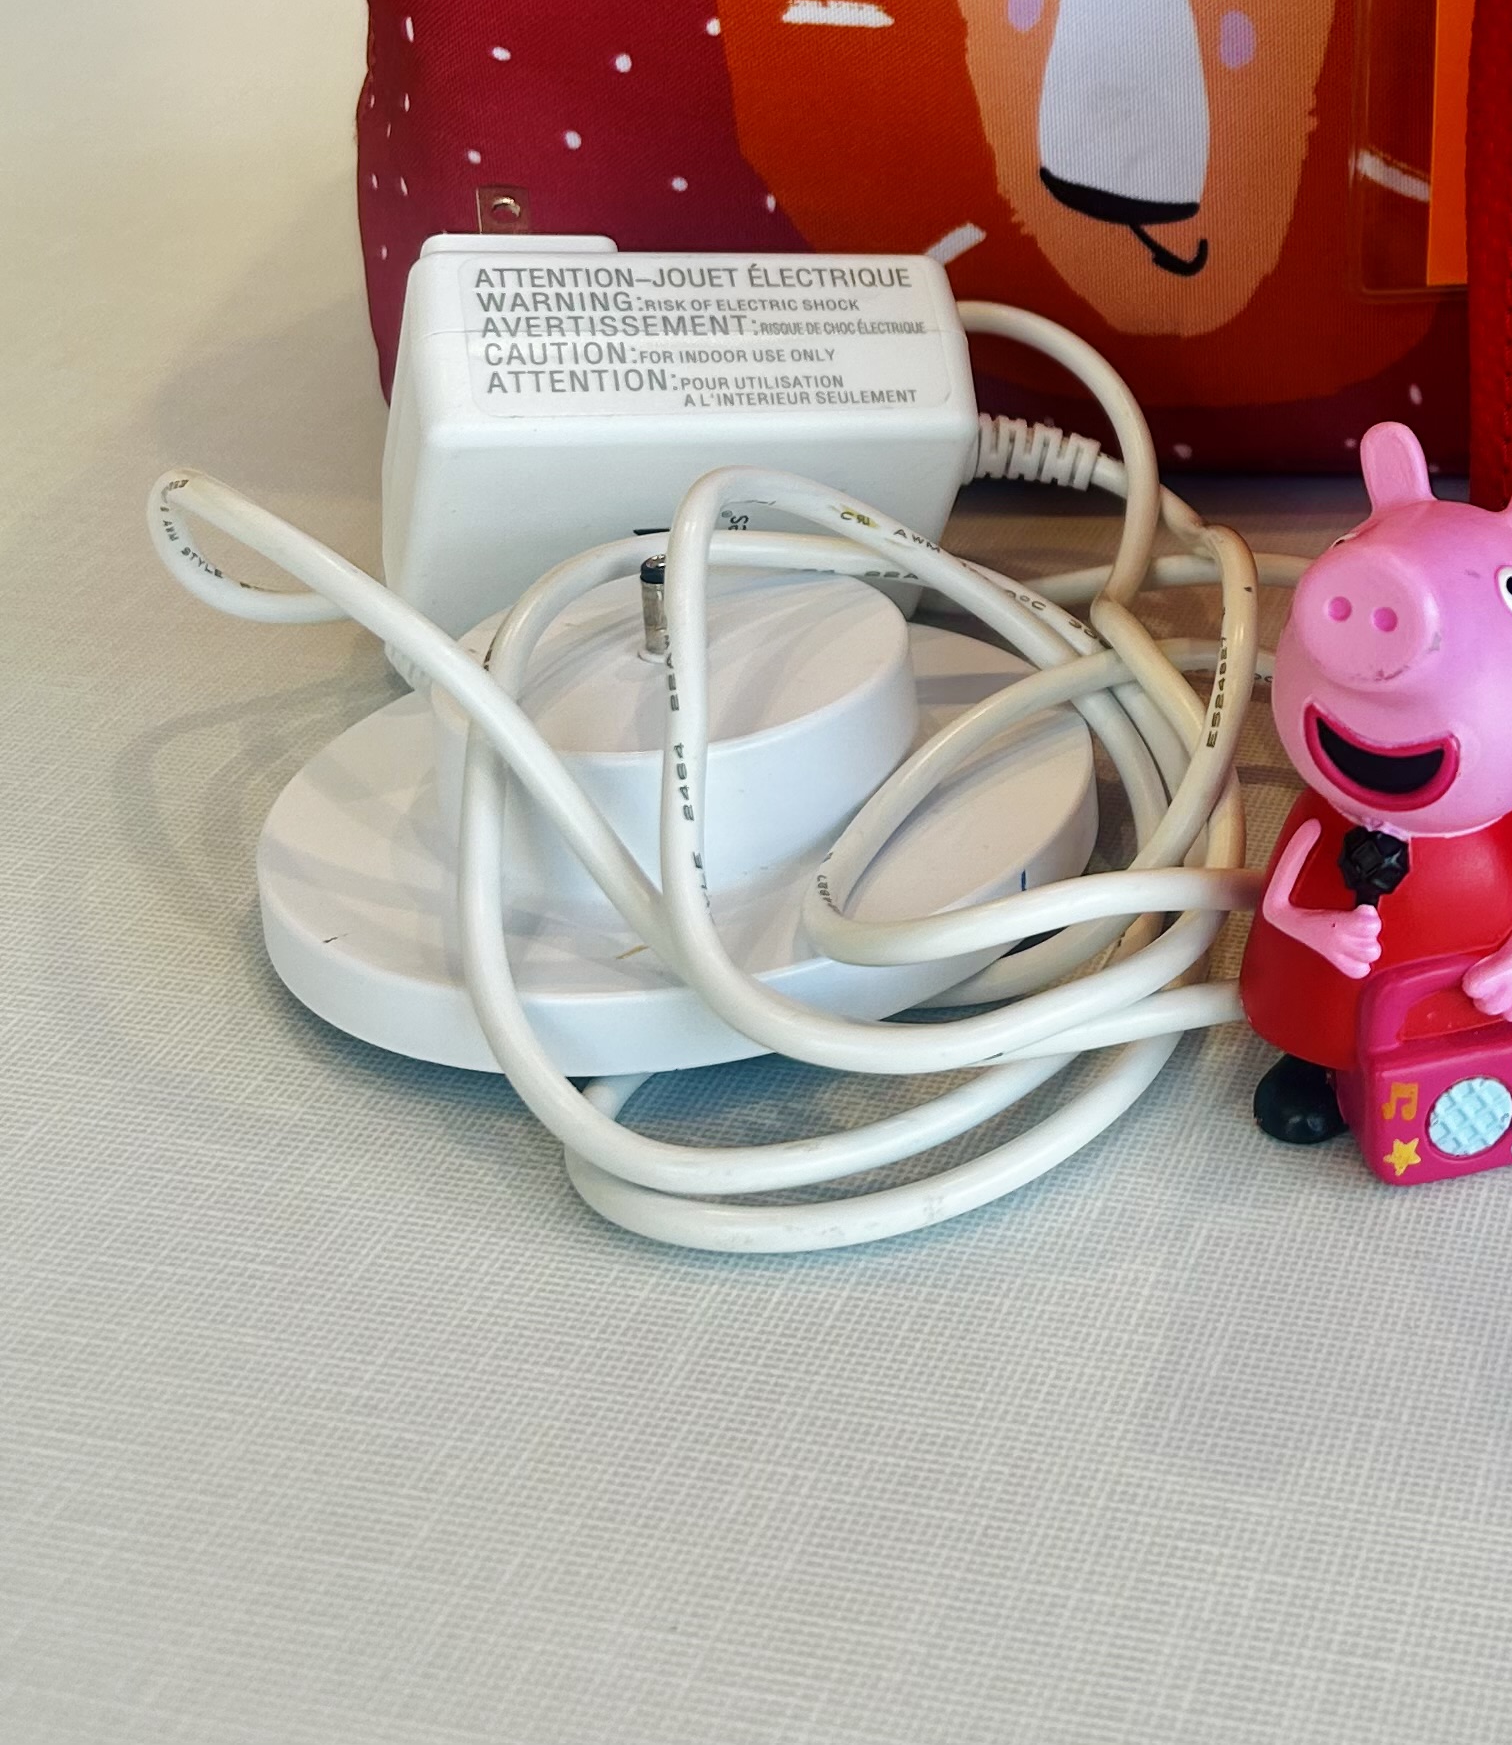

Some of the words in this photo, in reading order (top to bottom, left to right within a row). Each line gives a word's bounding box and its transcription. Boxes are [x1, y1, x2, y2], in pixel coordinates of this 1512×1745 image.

[749, 263, 913, 288] ÉLECTRIQUE
[691, 299, 713, 312] OF
[717, 299, 798, 312] ELECTRIC
[803, 299, 861, 312] SHOCK
[806, 322, 823, 335] DE
[824, 322, 856, 335] CHOC
[858, 319, 928, 335] ÉLECTRIQUE
[680, 350, 748, 364] INDOOR
[753, 349, 787, 363] USE
[790, 349, 836, 363] ONLY
[734, 375, 845, 390] UTILISATION
[684, 394, 697, 407] A
[701, 392, 811, 407] L'INTERIEUR
[815, 389, 917, 405] SEULEMENT
[893, 528, 941, 554] AWM
[180, 546, 224, 579] STYLE
